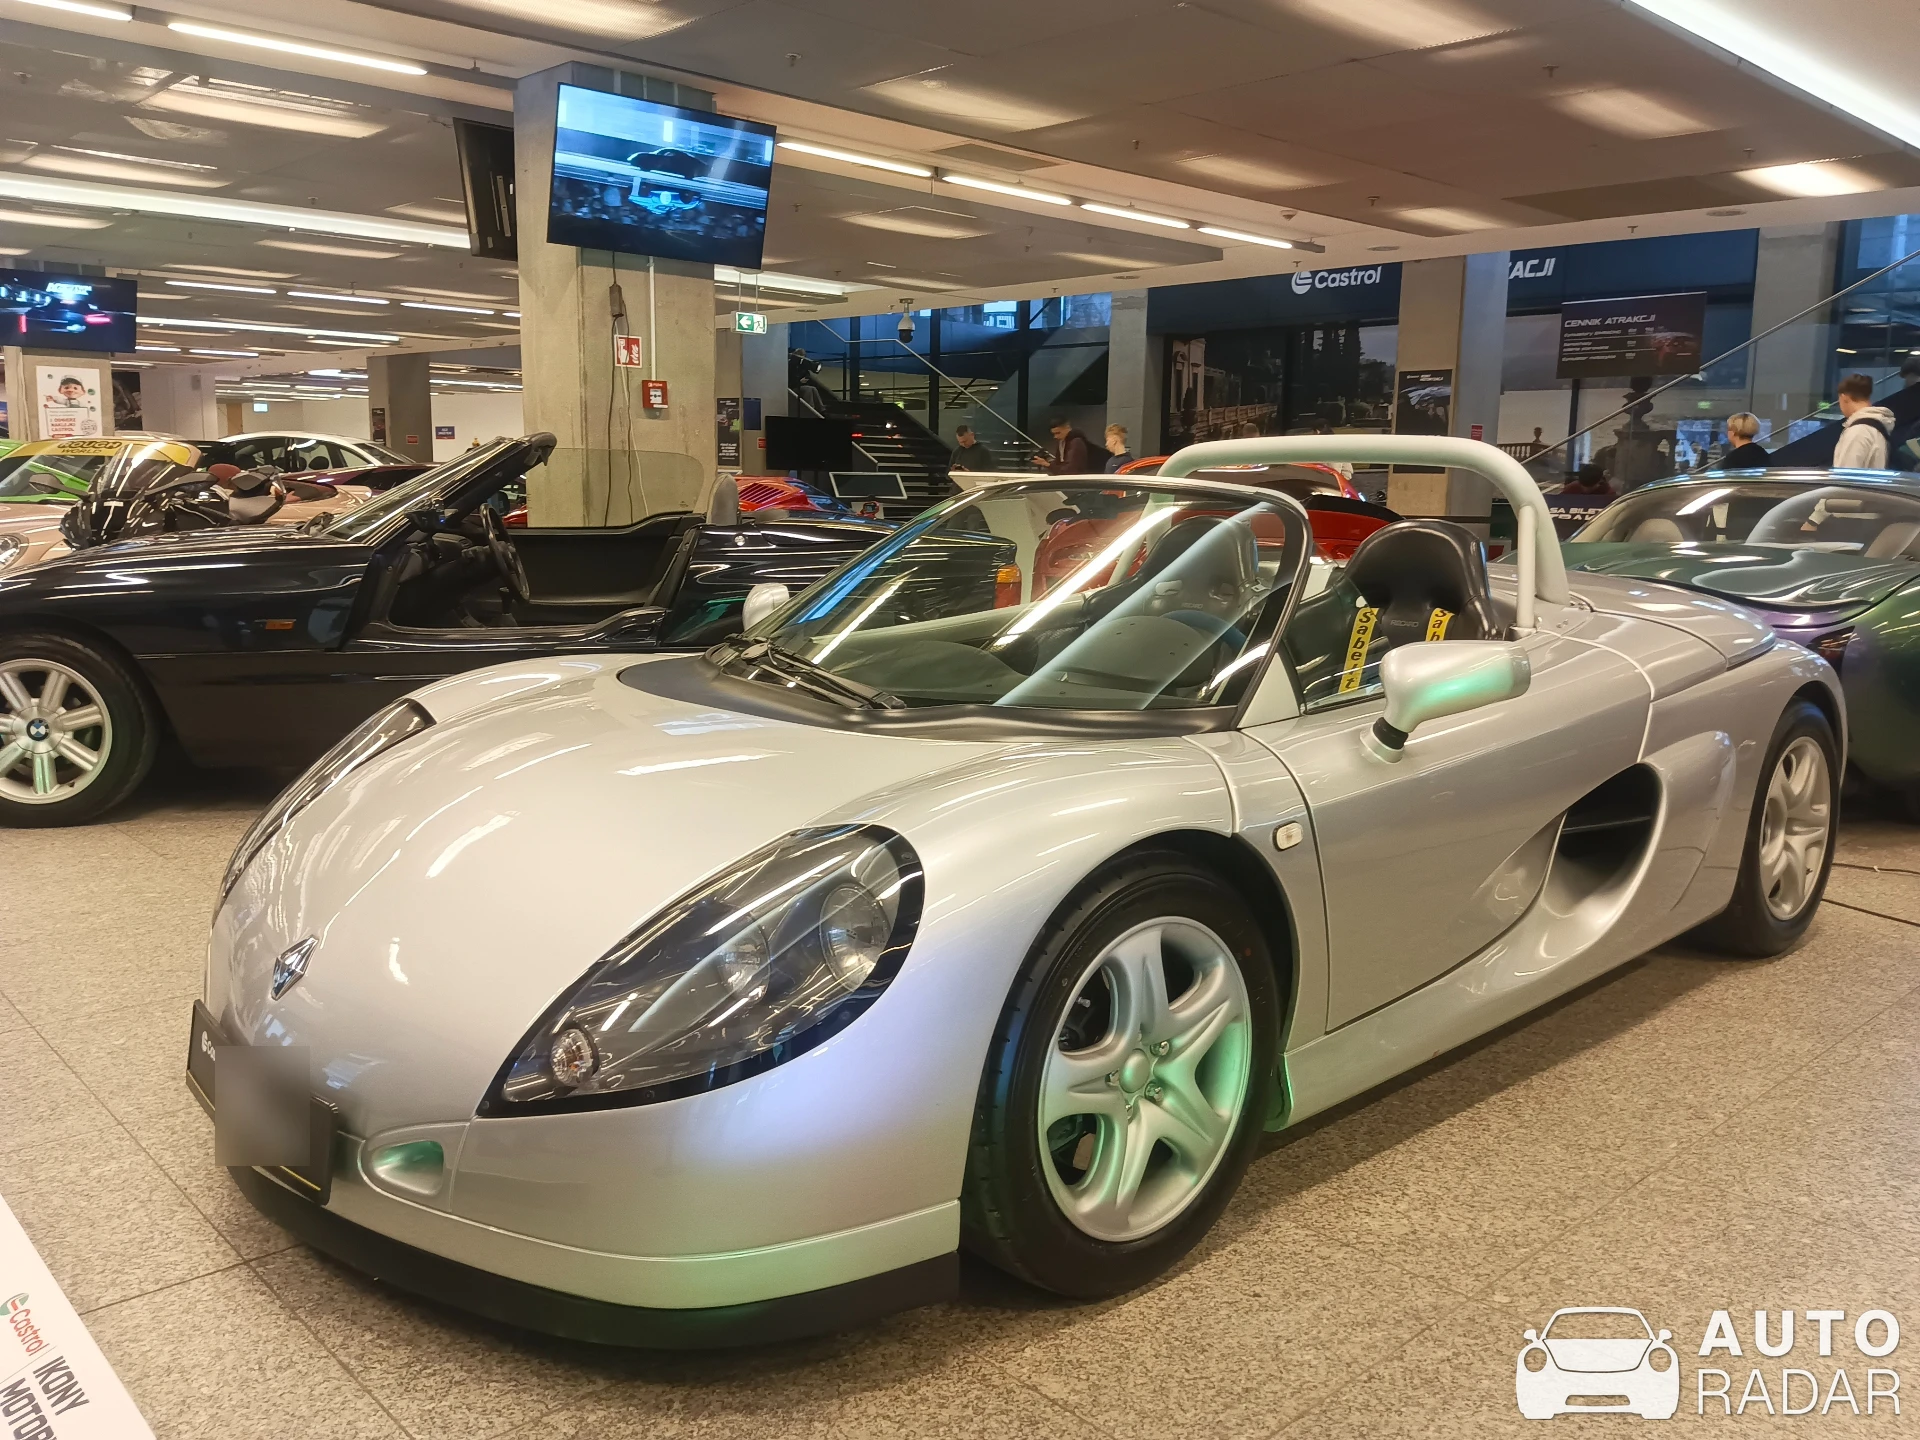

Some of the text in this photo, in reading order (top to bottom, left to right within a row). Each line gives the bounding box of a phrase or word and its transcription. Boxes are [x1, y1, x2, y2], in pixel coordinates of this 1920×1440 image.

[1314, 265, 1382, 289] Castrol
[1508, 257, 1556, 280] ACJI
[1564, 314, 1656, 328] CENNIK ATRAKCJI
[57, 440, 122, 449] ROUGH
[1345, 611, 1374, 689] Sabelt
[9, 1308, 50, 1357] Castrol
[33, 1355, 90, 1416] IKONY
